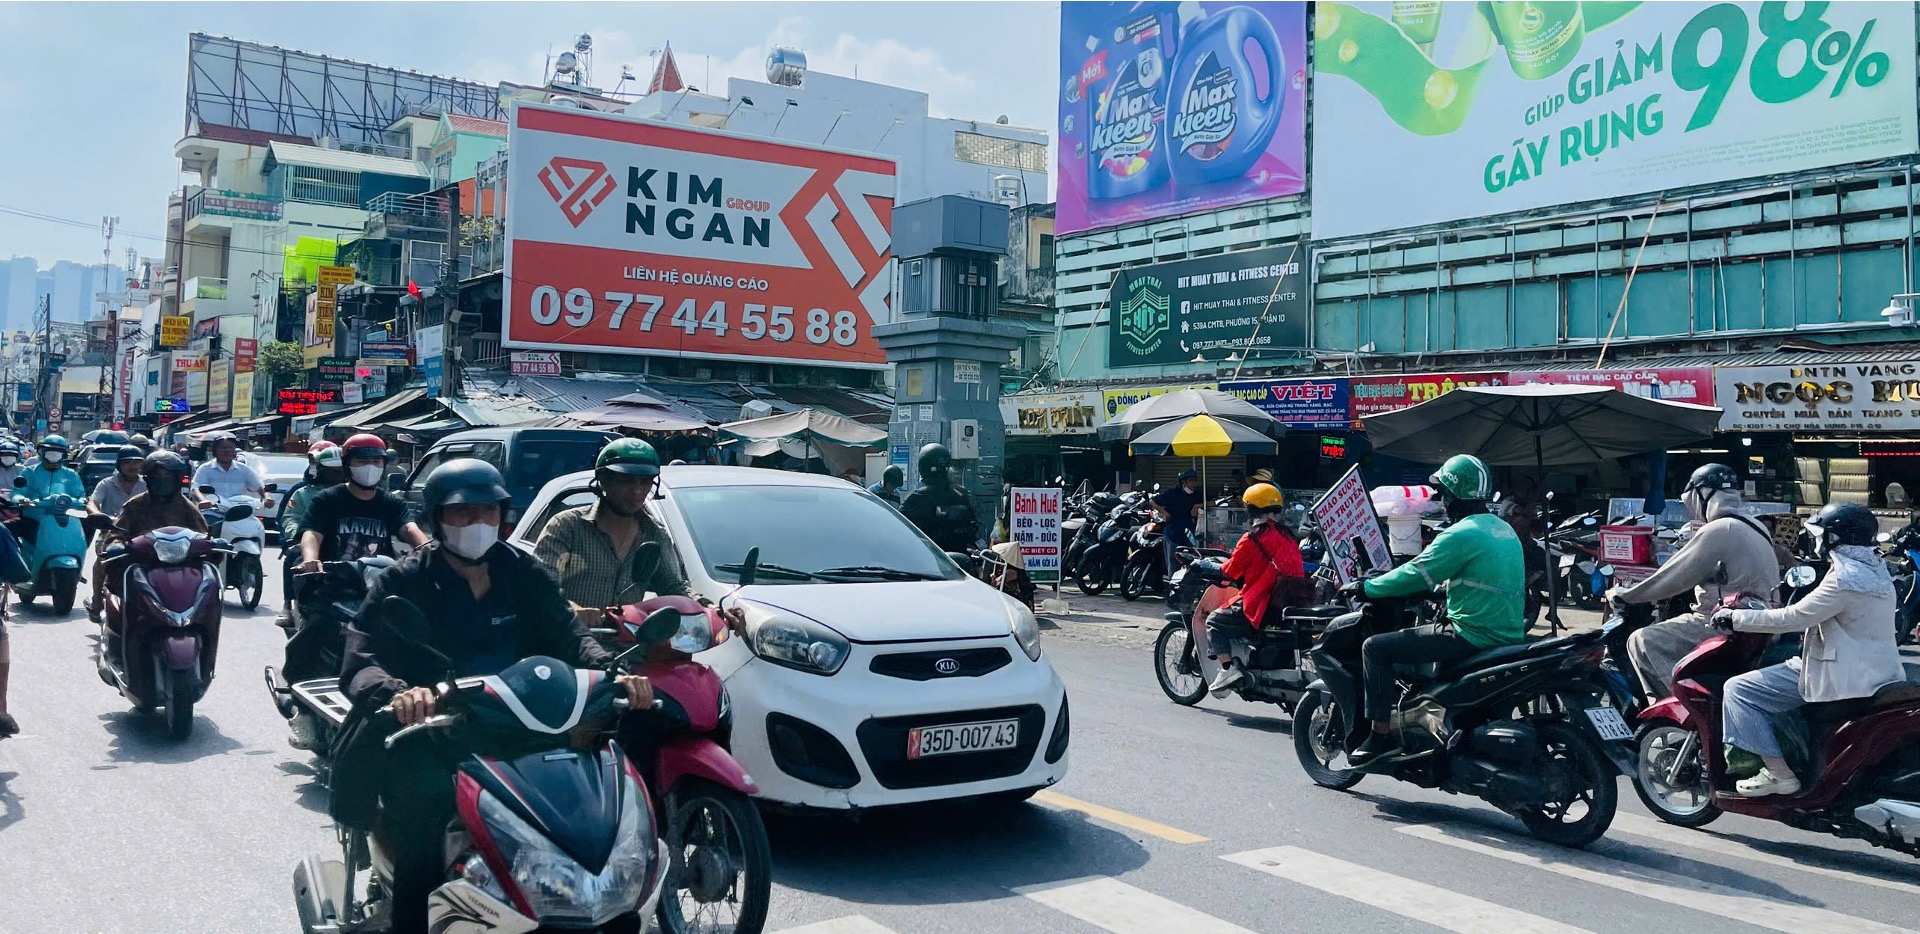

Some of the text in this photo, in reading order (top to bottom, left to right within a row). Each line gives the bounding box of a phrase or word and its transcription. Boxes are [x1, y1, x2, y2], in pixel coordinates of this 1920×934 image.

[1082, 60, 1102, 83] Mới
[1524, 1, 1891, 134] GIÚP GIẢM 98%
[1110, 89, 1158, 124] Max
[1188, 79, 1237, 114] Max
[1483, 134, 1550, 194] GÃY
[1560, 94, 1664, 168] RỤNG
[628, 166, 723, 207] KIM
[726, 197, 771, 213] GROUP
[626, 203, 770, 248] NGAN
[623, 265, 769, 291] LIÊN HỆ QUẢNG CÁO
[1129, 275, 1162, 293] MUAY THAI
[1178, 262, 1300, 288] HIT MUAY THAI & FITNESS CENTER
[1193, 302, 1203, 311] HIT
[1204, 300, 1221, 310] MUAY
[1221, 298, 1236, 308] THAI
[1243, 295, 1269, 306] FITNESS
[530, 285, 857, 347] 09 77 44 55 88
[1225, 316, 1251, 328] PHƯỜNG
[1279, 314, 1286, 323] 10
[1126, 338, 1162, 356] FITNESS CENTER
[176, 359, 206, 368] THU AN
[513, 363, 555, 373] 09 77 44 55 88
[1790, 366, 1847, 379] DNTN
[1567, 373, 1590, 382] TIỆM
[1593, 373, 1611, 382] BẠC
[1614, 372, 1632, 380] CAO
[1247, 389, 1258, 400] CAO
[1271, 381, 1337, 404] VIỆT
[1734, 380, 1854, 410] NGỌC
[1355, 403, 1369, 412] Nhận
[1370, 404, 1378, 412] gia
[1742, 408, 1920, 419] CHUYÊN MUA BÁN TRANG S
[1322, 445, 1345, 458] VIỆT
[1338, 476, 1358, 499] SƯỜN
[1014, 491, 1059, 514] Bánh Huế
[1322, 485, 1364, 531] GIA TRUYỀN
[1016, 516, 1032, 528] BÈO
[1040, 518, 1055, 530] LỌC
[1014, 531, 1033, 544] NẬM
[1041, 530, 1057, 542] ĐÚC
[940, 661, 957, 670] KIA
[921, 724, 1015, 753] 35D-007.43
